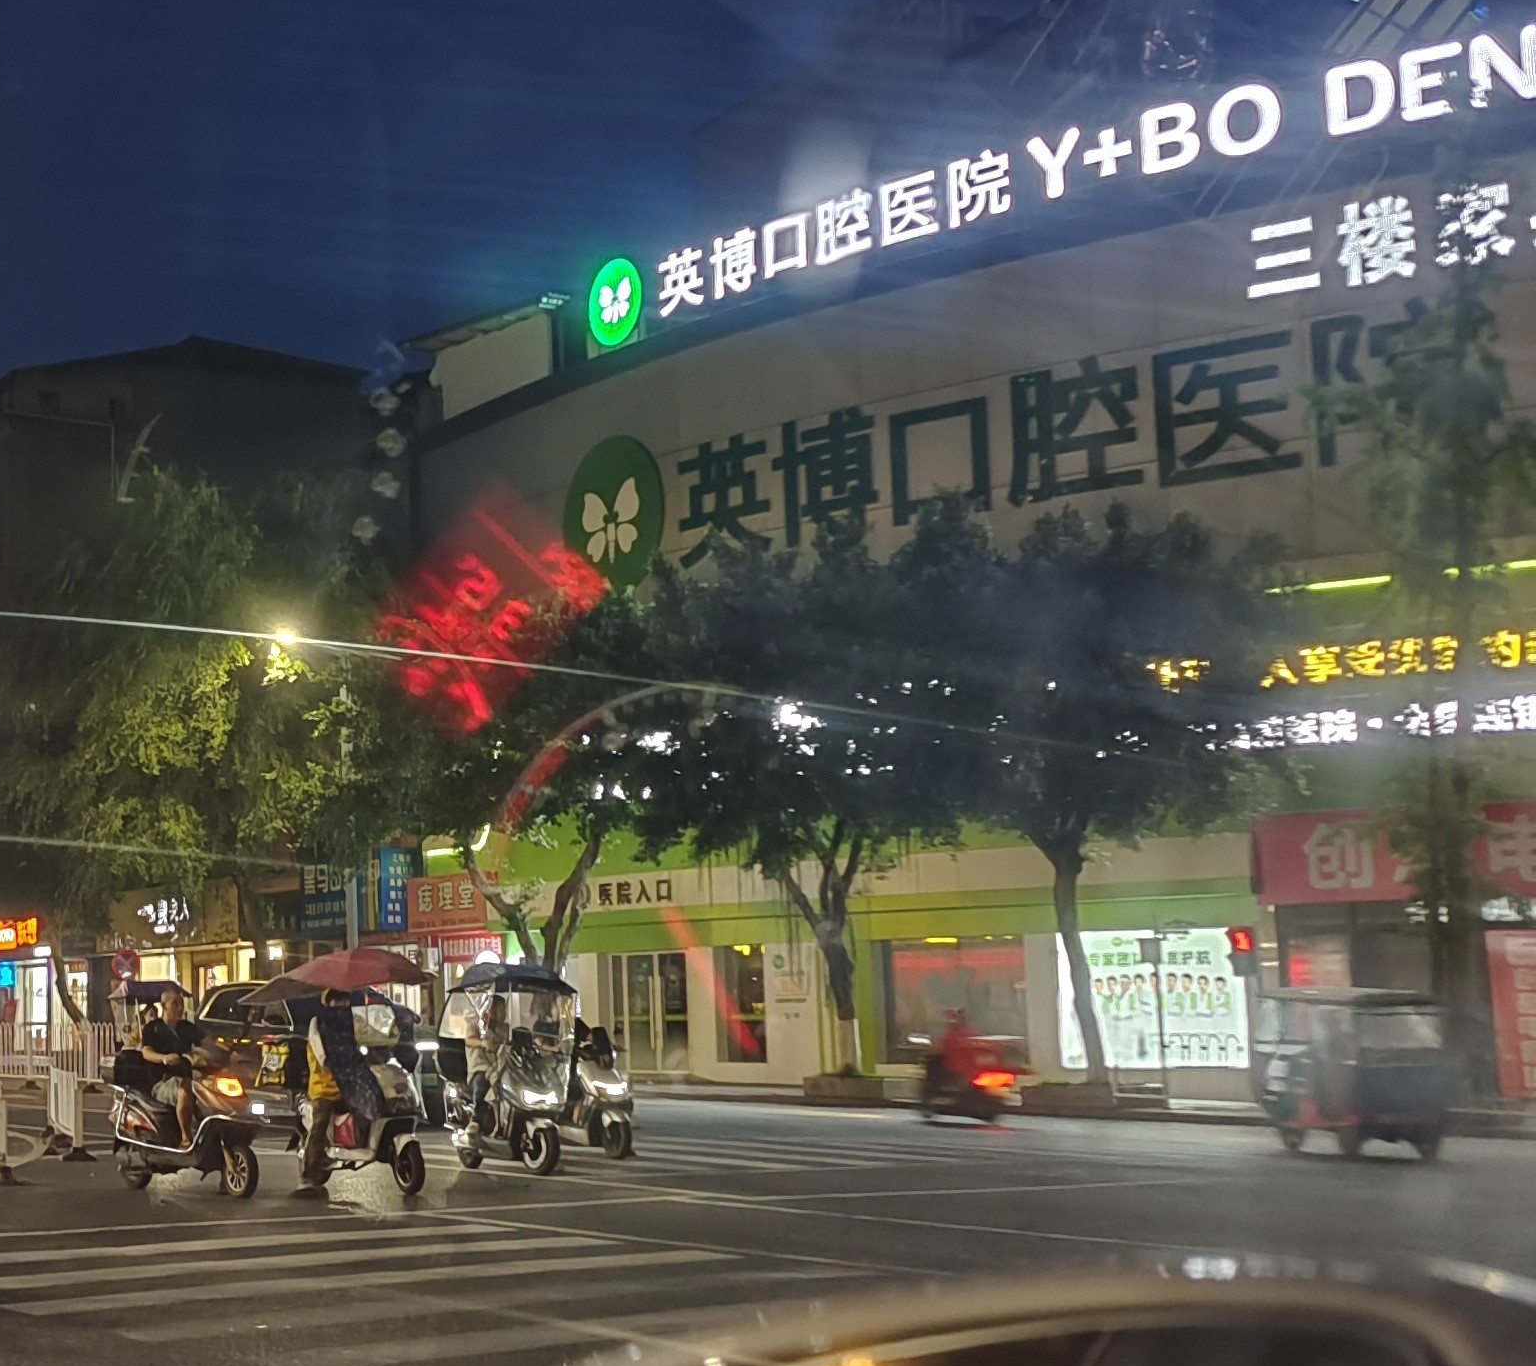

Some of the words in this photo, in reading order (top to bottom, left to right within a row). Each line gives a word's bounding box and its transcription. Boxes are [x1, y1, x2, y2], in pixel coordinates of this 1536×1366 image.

[1026, 83, 1282, 200] Y+BO
[1324, 23, 1536, 137] DEN
[656, 148, 1011, 319] 英博口腔医院
[598, 878, 673, 907] 医院入口
